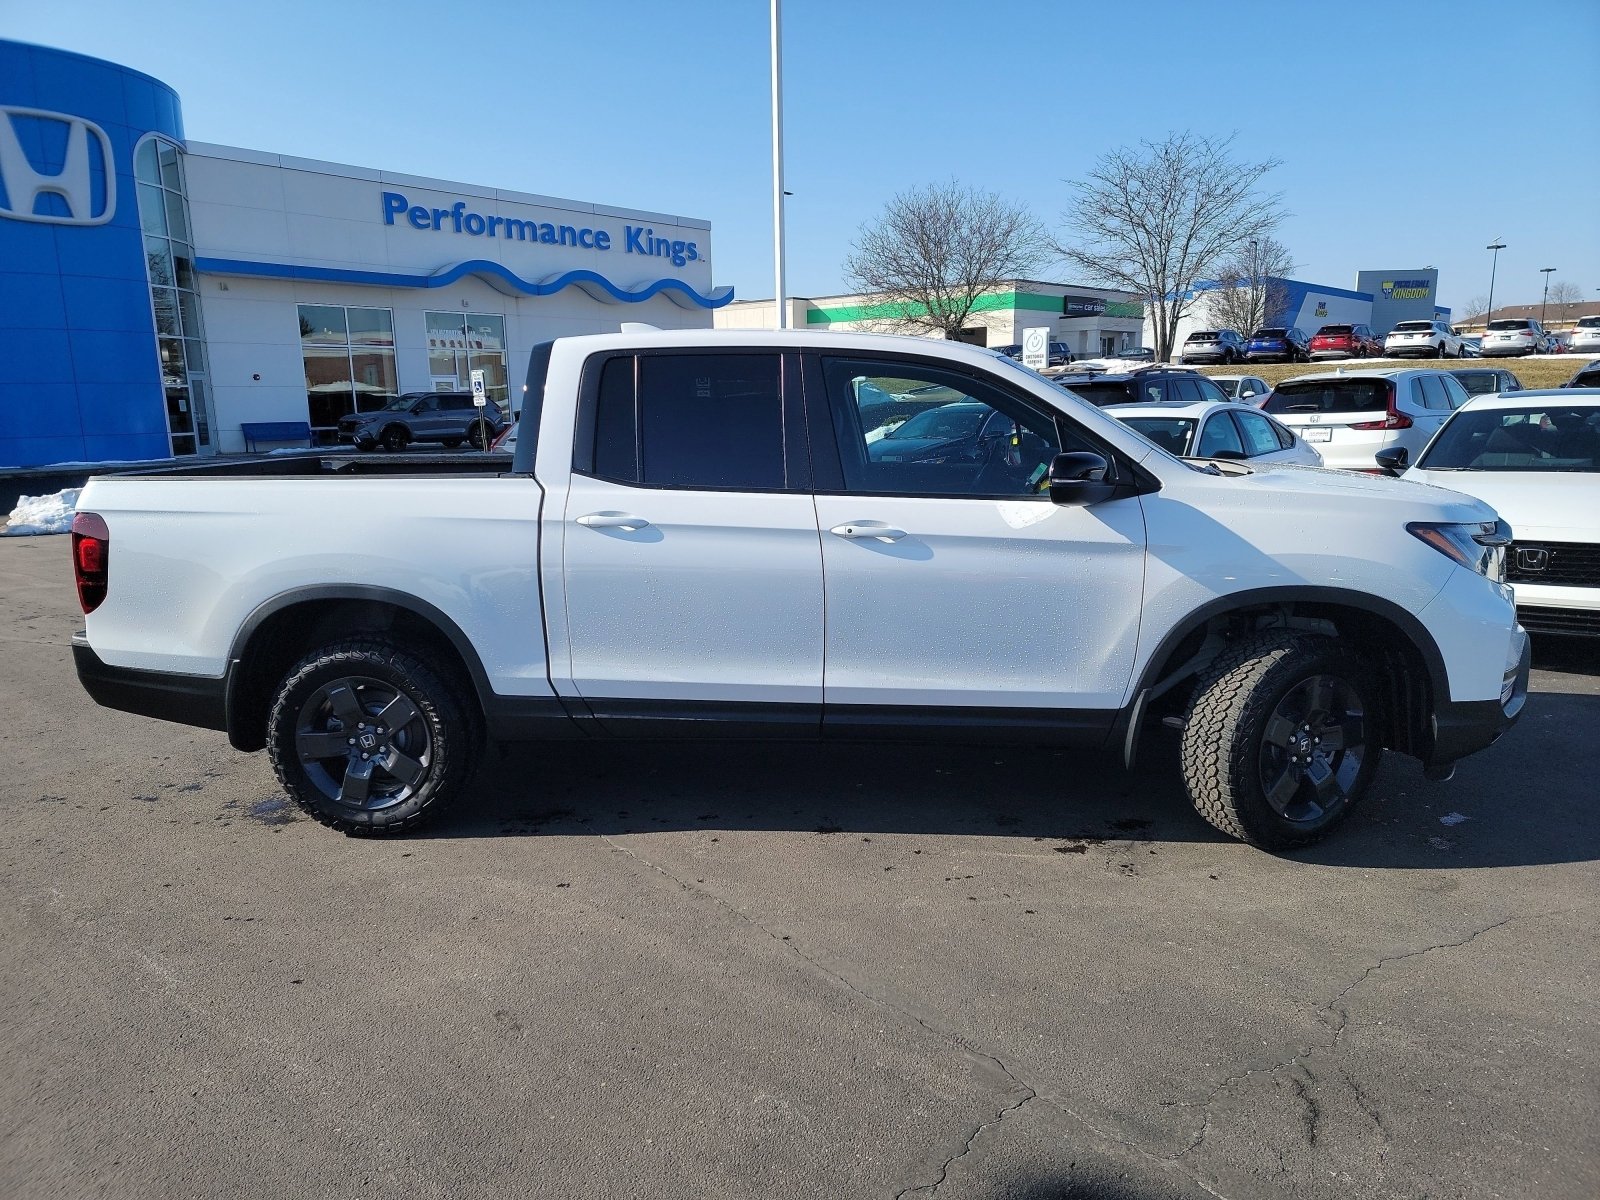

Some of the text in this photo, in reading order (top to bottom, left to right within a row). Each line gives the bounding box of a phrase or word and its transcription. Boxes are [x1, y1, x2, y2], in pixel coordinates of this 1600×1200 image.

[383, 191, 697, 267] Performance Kings
[1392, 288, 1429, 299] KINGDOM
